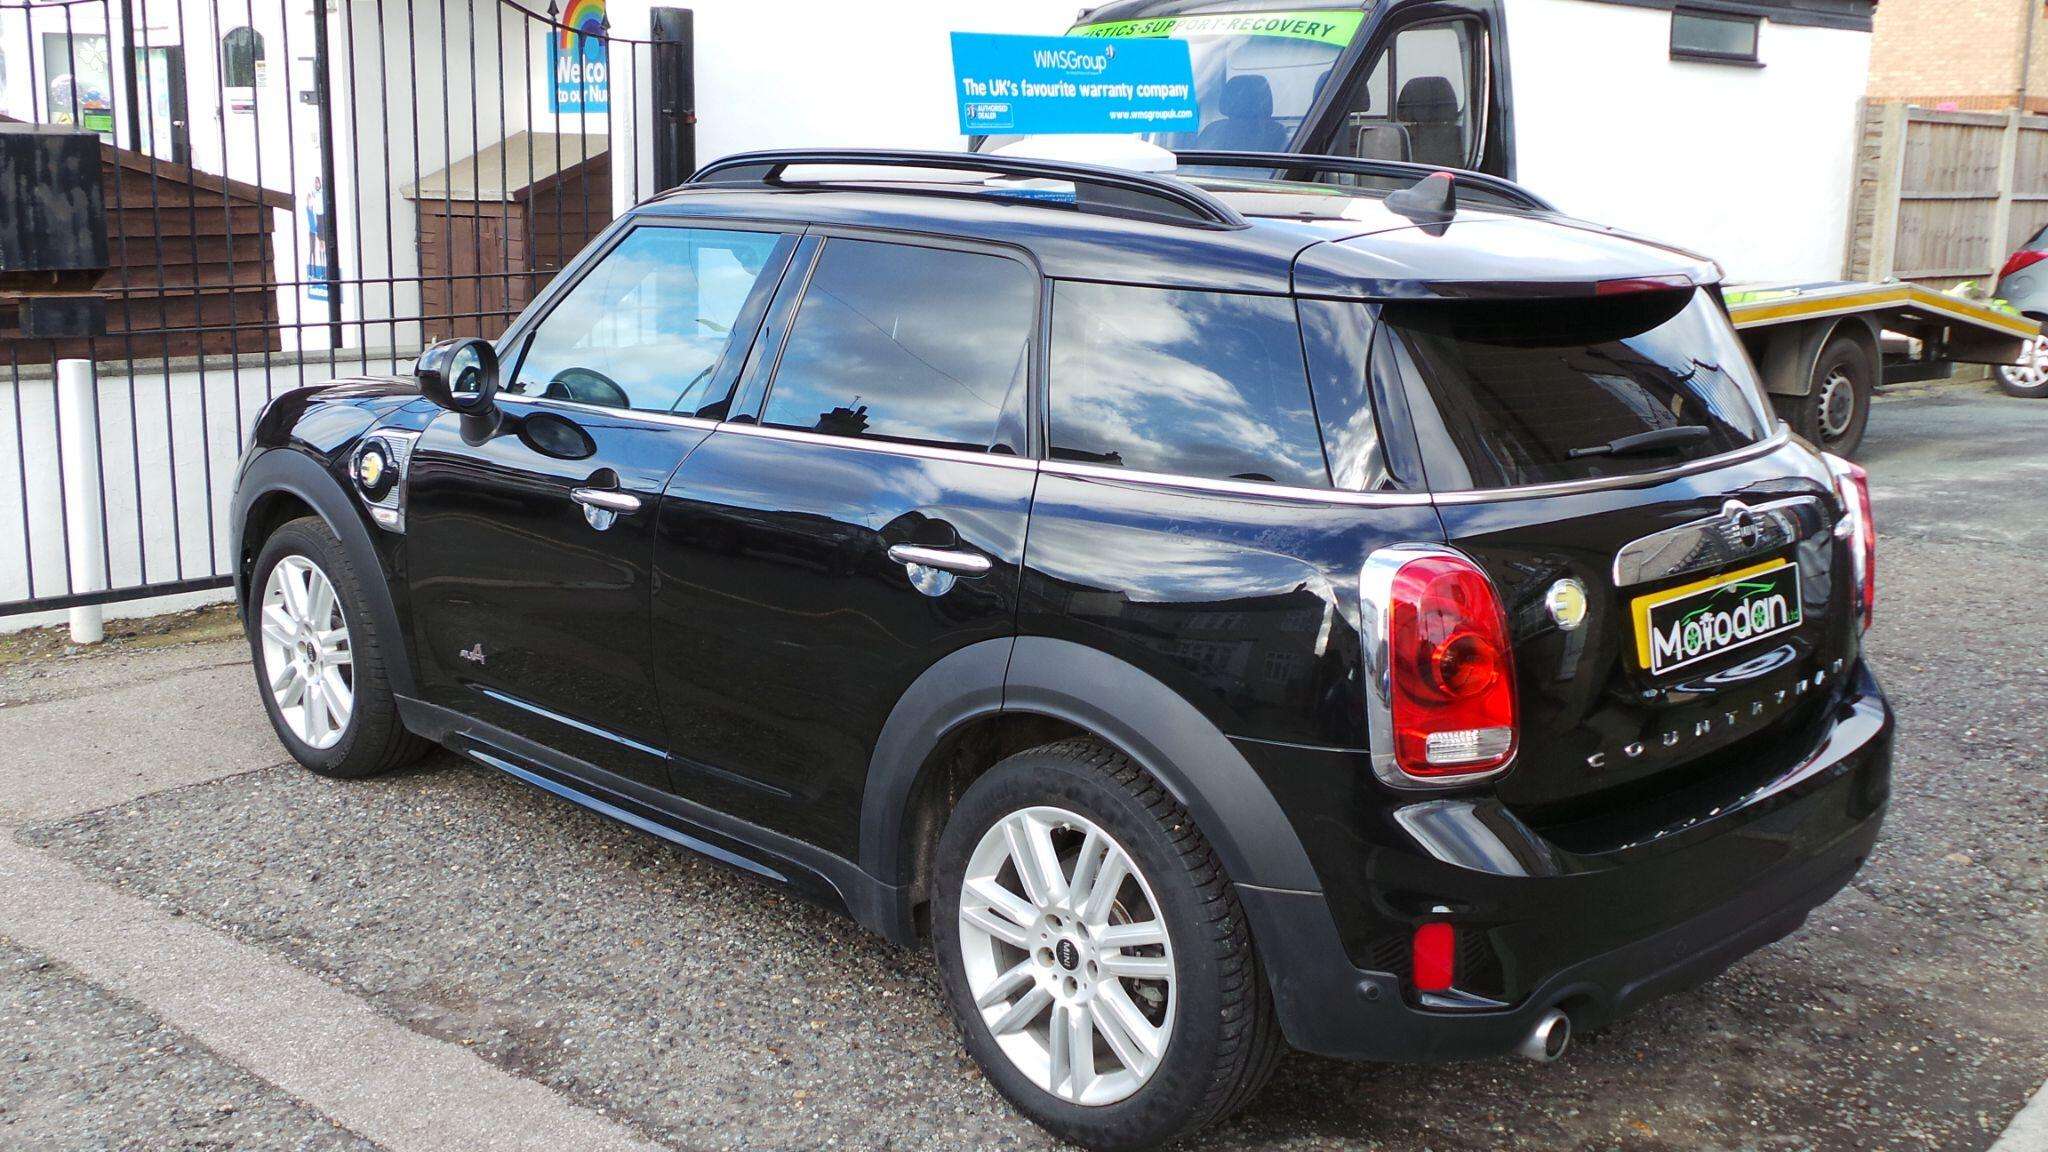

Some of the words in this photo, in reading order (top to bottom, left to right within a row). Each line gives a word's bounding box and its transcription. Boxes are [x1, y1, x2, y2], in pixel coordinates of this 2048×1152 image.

[558, 54, 607, 83] Welco
[1033, 50, 1107, 73] WMSGroup
[558, 88, 569, 103] to
[963, 78, 987, 97] The
[989, 79, 1019, 97] UK's
[1021, 79, 1076, 98] favourite
[1079, 83, 1134, 101] warranty
[1136, 83, 1189, 100] company
[1652, 594, 1787, 668] Motodan
[1587, 658, 1843, 768] COUNTRYMAN
[1063, 941, 1071, 967] MINI
